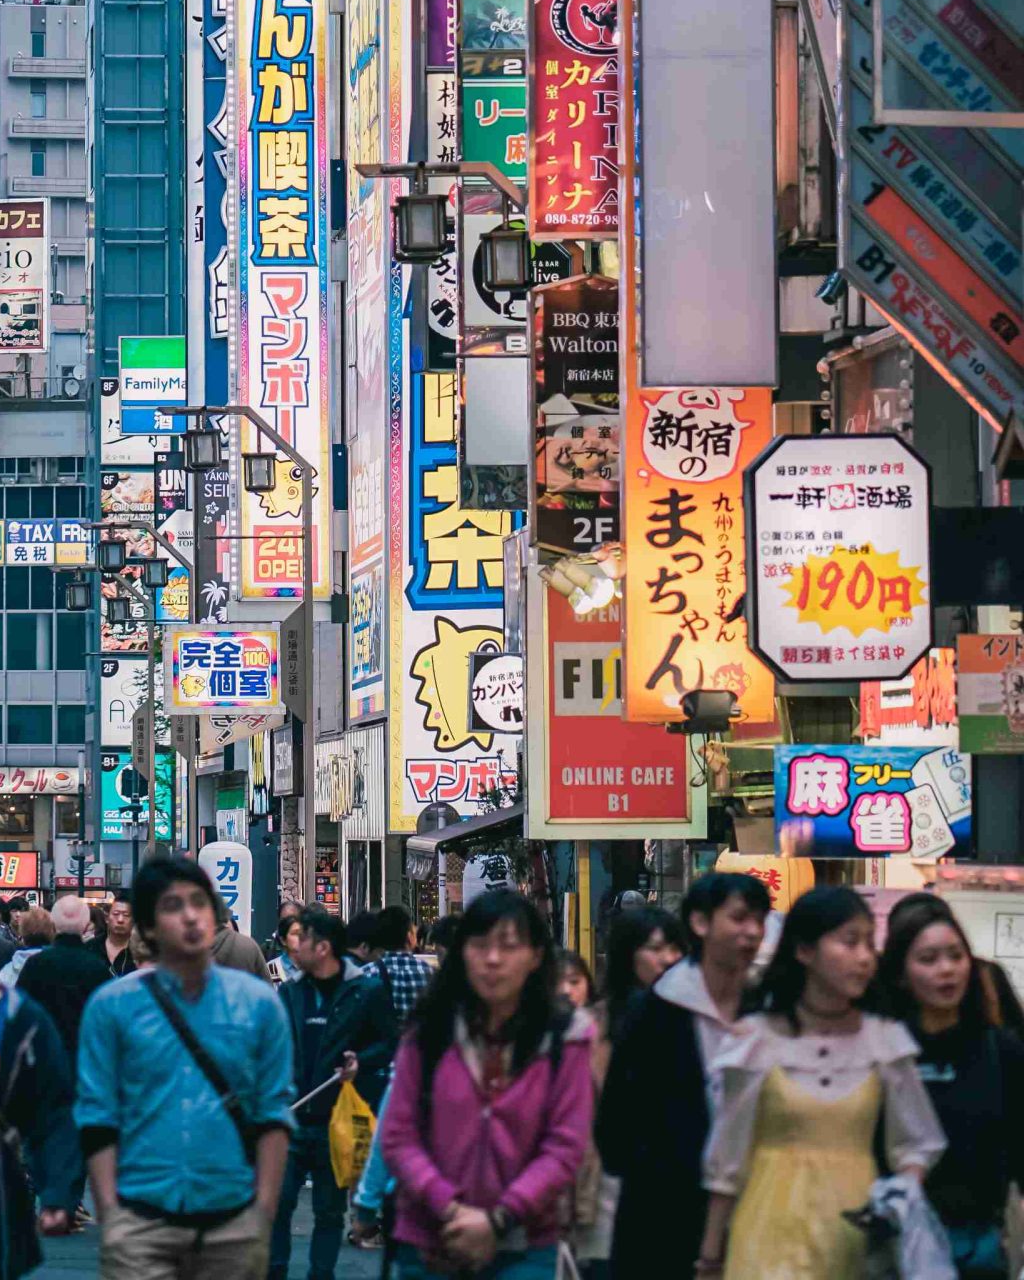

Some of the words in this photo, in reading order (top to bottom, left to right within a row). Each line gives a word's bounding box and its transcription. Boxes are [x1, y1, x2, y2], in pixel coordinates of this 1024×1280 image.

[545, 59, 560, 210] 個室ダイニング
[560, 59, 593, 210] カリーナ
[855, 242, 896, 285] B1
[552, 312, 590, 329] BBQ
[266, 277, 305, 450] マンボー
[567, 369, 614, 382] 新宿本店
[103, 381, 115, 392] 8F
[103, 474, 115, 486] 6F
[23, 524, 55, 542] TAX
[572, 517, 614, 544] 2F
[14, 545, 48, 562] 免税
[257, 530, 304, 557] 24
[257, 559, 304, 579] OPE
[710, 492, 737, 643] 九州のうまかもん
[644, 487, 710, 696] まっちゃん
[795, 560, 913, 614] 190円
[182, 641, 242, 669] 完全
[103, 662, 115, 673] 2F
[209, 669, 268, 697] 個室
[561, 766, 625, 786] ONLINE
[631, 766, 675, 786] CAFE
[853, 764, 913, 786] フリー
[607, 793, 629, 812] B1
